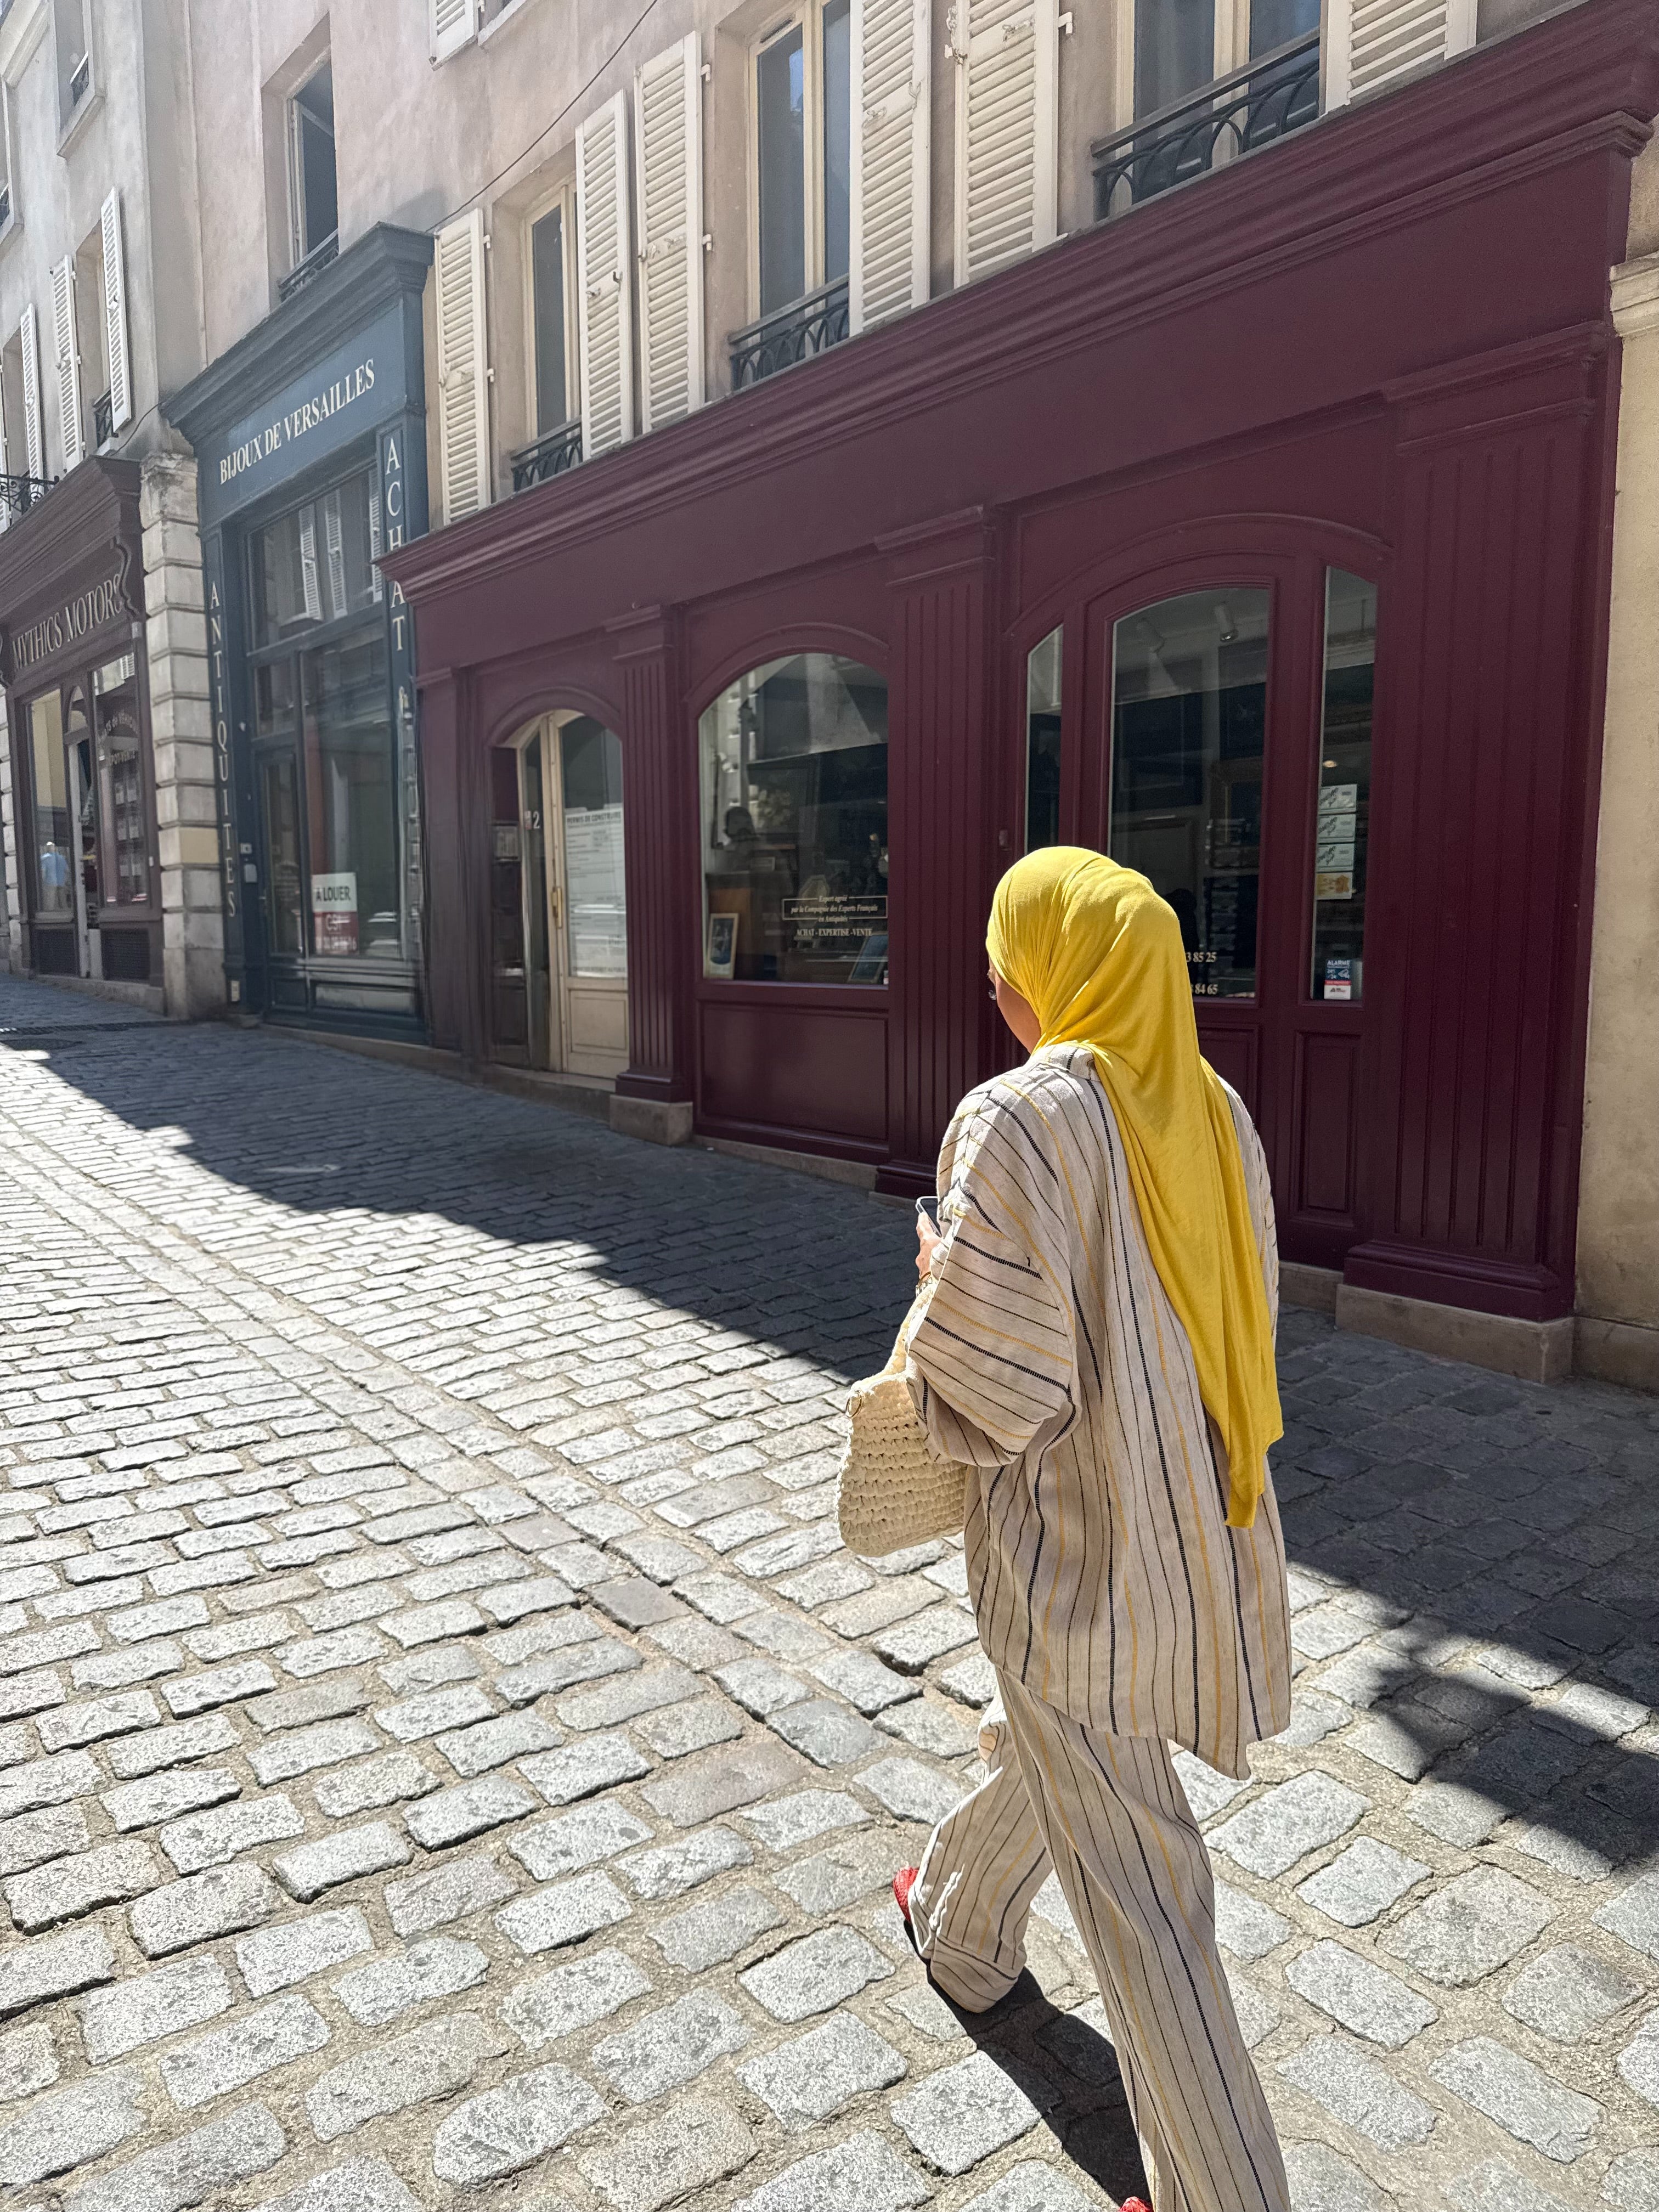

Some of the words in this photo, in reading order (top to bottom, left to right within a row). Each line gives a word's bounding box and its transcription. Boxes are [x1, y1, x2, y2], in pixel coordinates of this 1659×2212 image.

[220, 435, 263, 485] BIJOUX
[264, 422, 281, 456] DE
[284, 358, 375, 442] VERSAILLES
[13, 612, 62, 671] MYTHICS
[65, 573, 123, 642] MOTORS
[210, 580, 236, 917] ANTIQUITES
[324, 886, 351, 901] LOUER
[819, 895, 834, 904] Expert
[857, 904, 878, 913] Français
[819, 928, 850, 936] EXPERTISE
[1193, 952, 1204, 962] 85
[1205, 952, 1217, 962] 25
[1195, 983, 1205, 994] 84
[1207, 984, 1218, 995] 65
